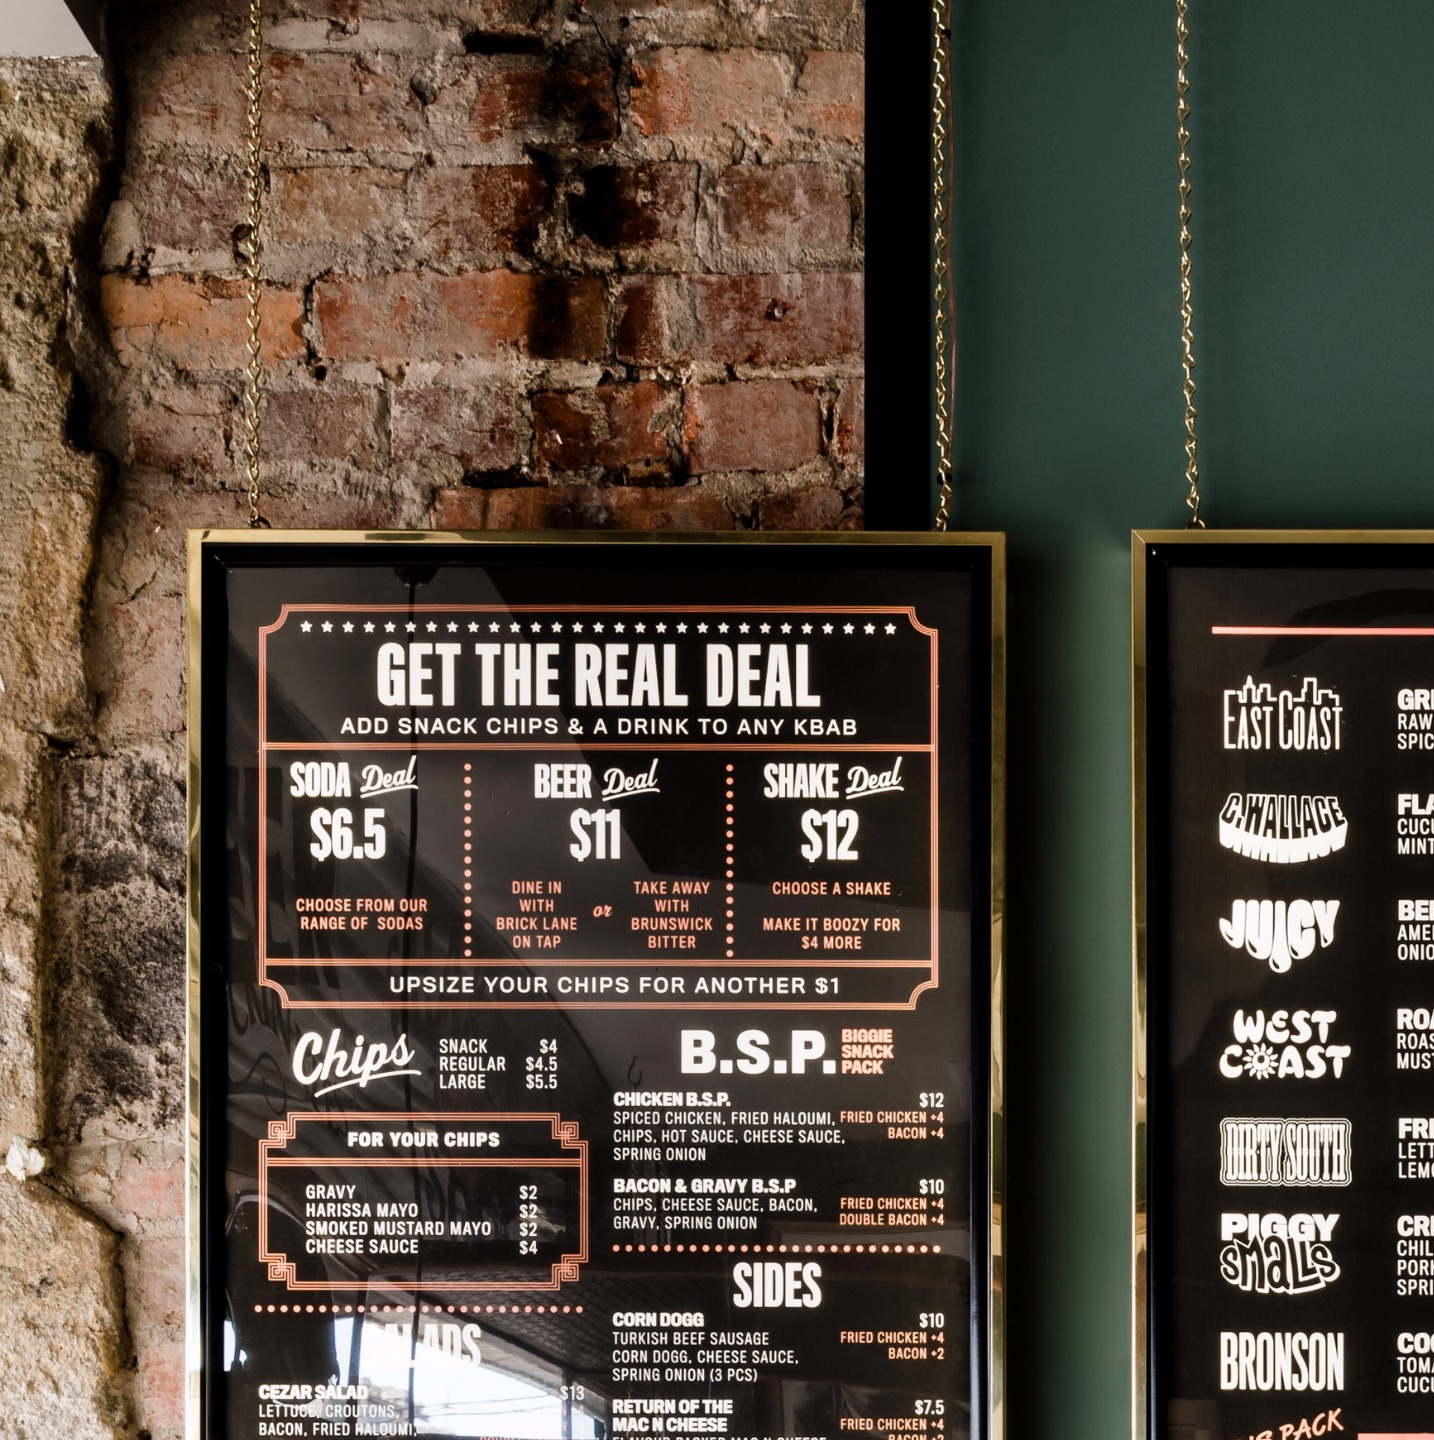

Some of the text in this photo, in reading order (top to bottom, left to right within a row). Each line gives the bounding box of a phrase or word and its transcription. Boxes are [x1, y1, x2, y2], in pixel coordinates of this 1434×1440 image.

[376, 641, 821, 708] GET THE REAL DEAL
[339, 716, 857, 736] ADD SNACK CHIPS & A DRINK TO ANY KBAB
[1222, 687, 1344, 751] EAST COAST
[1397, 712, 1434, 731] RAW
[289, 754, 420, 799] SODA Deal
[533, 757, 661, 802] BEER Deal
[763, 755, 905, 801] SHAKE Deal
[309, 806, 387, 862] $6.5
[569, 807, 621, 863] $11
[800, 808, 860, 863] $12
[1218, 898, 1341, 974] JUICY
[389, 975, 839, 995] UPSIZE YOUR CHIPS FOR ANOTHER $1
[840, 1027, 894, 1045] BIGGIE
[1232, 1008, 1338, 1046] WEST
[291, 1027, 423, 1099] Chips
[439, 1055, 506, 1072] REGULAR
[525, 1055, 558, 1072] $4.5
[680, 1028, 837, 1076] B.S.P.
[840, 1043, 895, 1060] SNACK
[840, 1058, 885, 1075] PACK
[613, 1091, 732, 1108] CHICKEN B.S.P.
[918, 1091, 945, 1109] $12
[347, 1131, 501, 1148] FOR YOUR CHIPS
[1224, 1121, 1348, 1183] DIRTY SOUTH
[305, 1202, 419, 1218] HARISSA MAYO
[519, 1202, 540, 1221] $2
[613, 1197, 818, 1213] CHIPS, CHEESE SAUCE, BACON,
[1220, 1212, 1341, 1242] PIGGY
[730, 1261, 823, 1309] SIDES
[612, 1311, 705, 1328] CORN DOGG
[918, 1312, 945, 1329] $10
[1219, 1331, 1345, 1392] BRONSON
